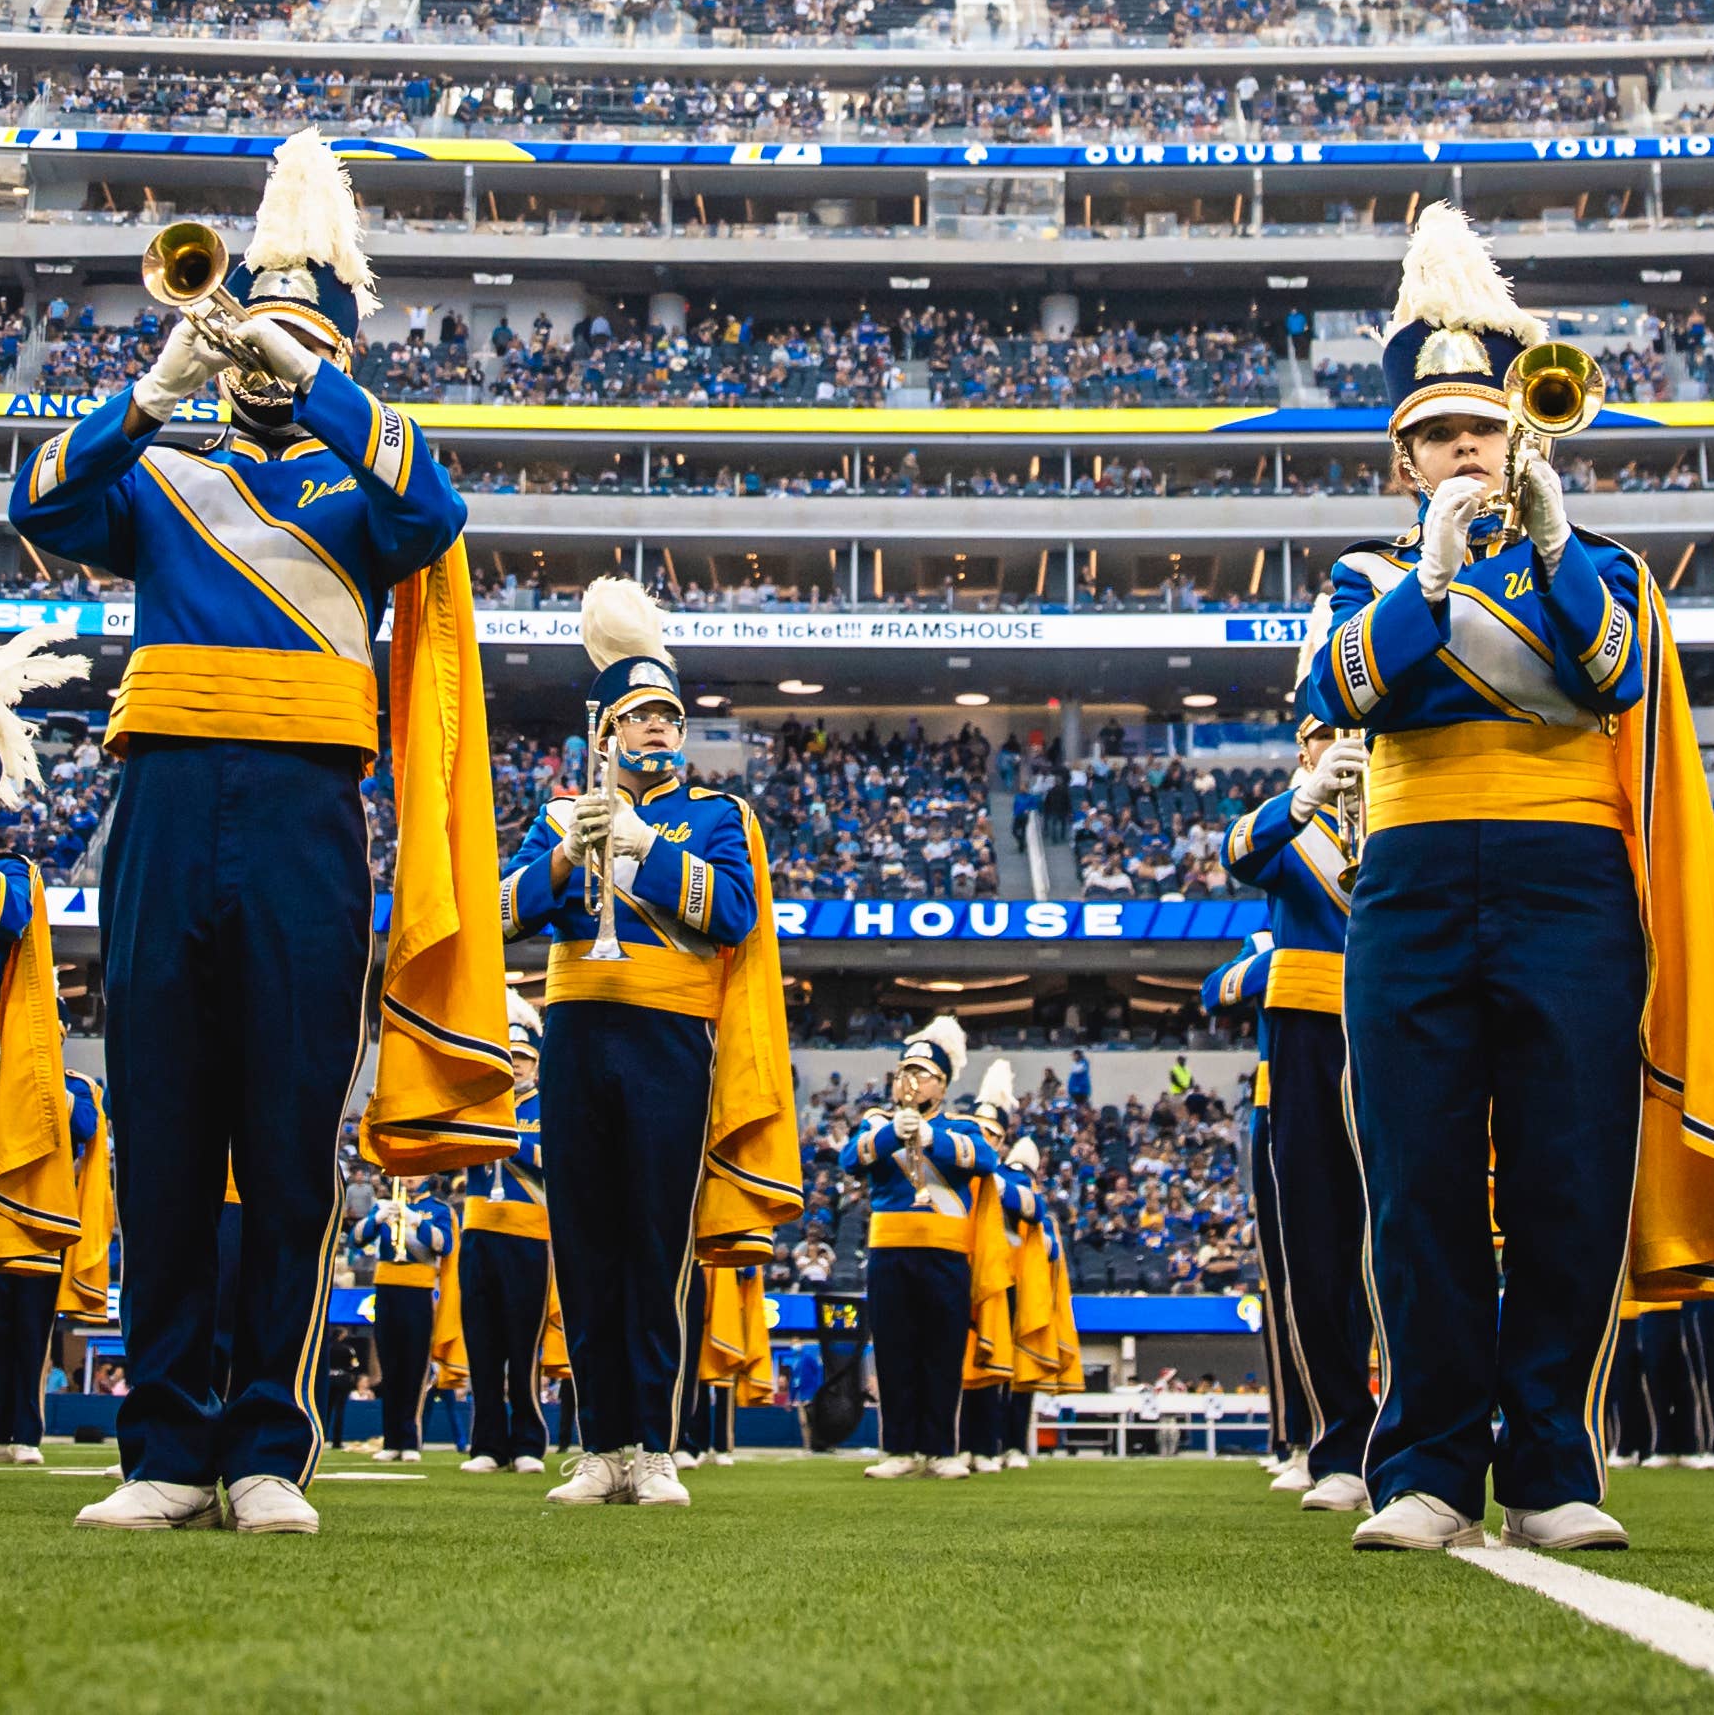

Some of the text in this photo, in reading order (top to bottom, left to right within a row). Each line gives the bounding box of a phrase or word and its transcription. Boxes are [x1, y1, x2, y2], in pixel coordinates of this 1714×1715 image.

[1085, 143, 1323, 164] OUR HOUSE
[1531, 138, 1638, 160] YOUR
[6, 392, 219, 422] ANGES
[108, 613, 130, 627] or
[486, 621, 537, 638] sick,
[693, 622, 724, 637] for
[734, 622, 768, 637] the
[777, 621, 862, 638] ticket!!!
[871, 622, 1044, 639] #RAMSHOUSE
[1251, 620, 1305, 640] 10:1
[688, 866, 704, 915] BRUINS
[854, 902, 1123, 937] HOUSE
